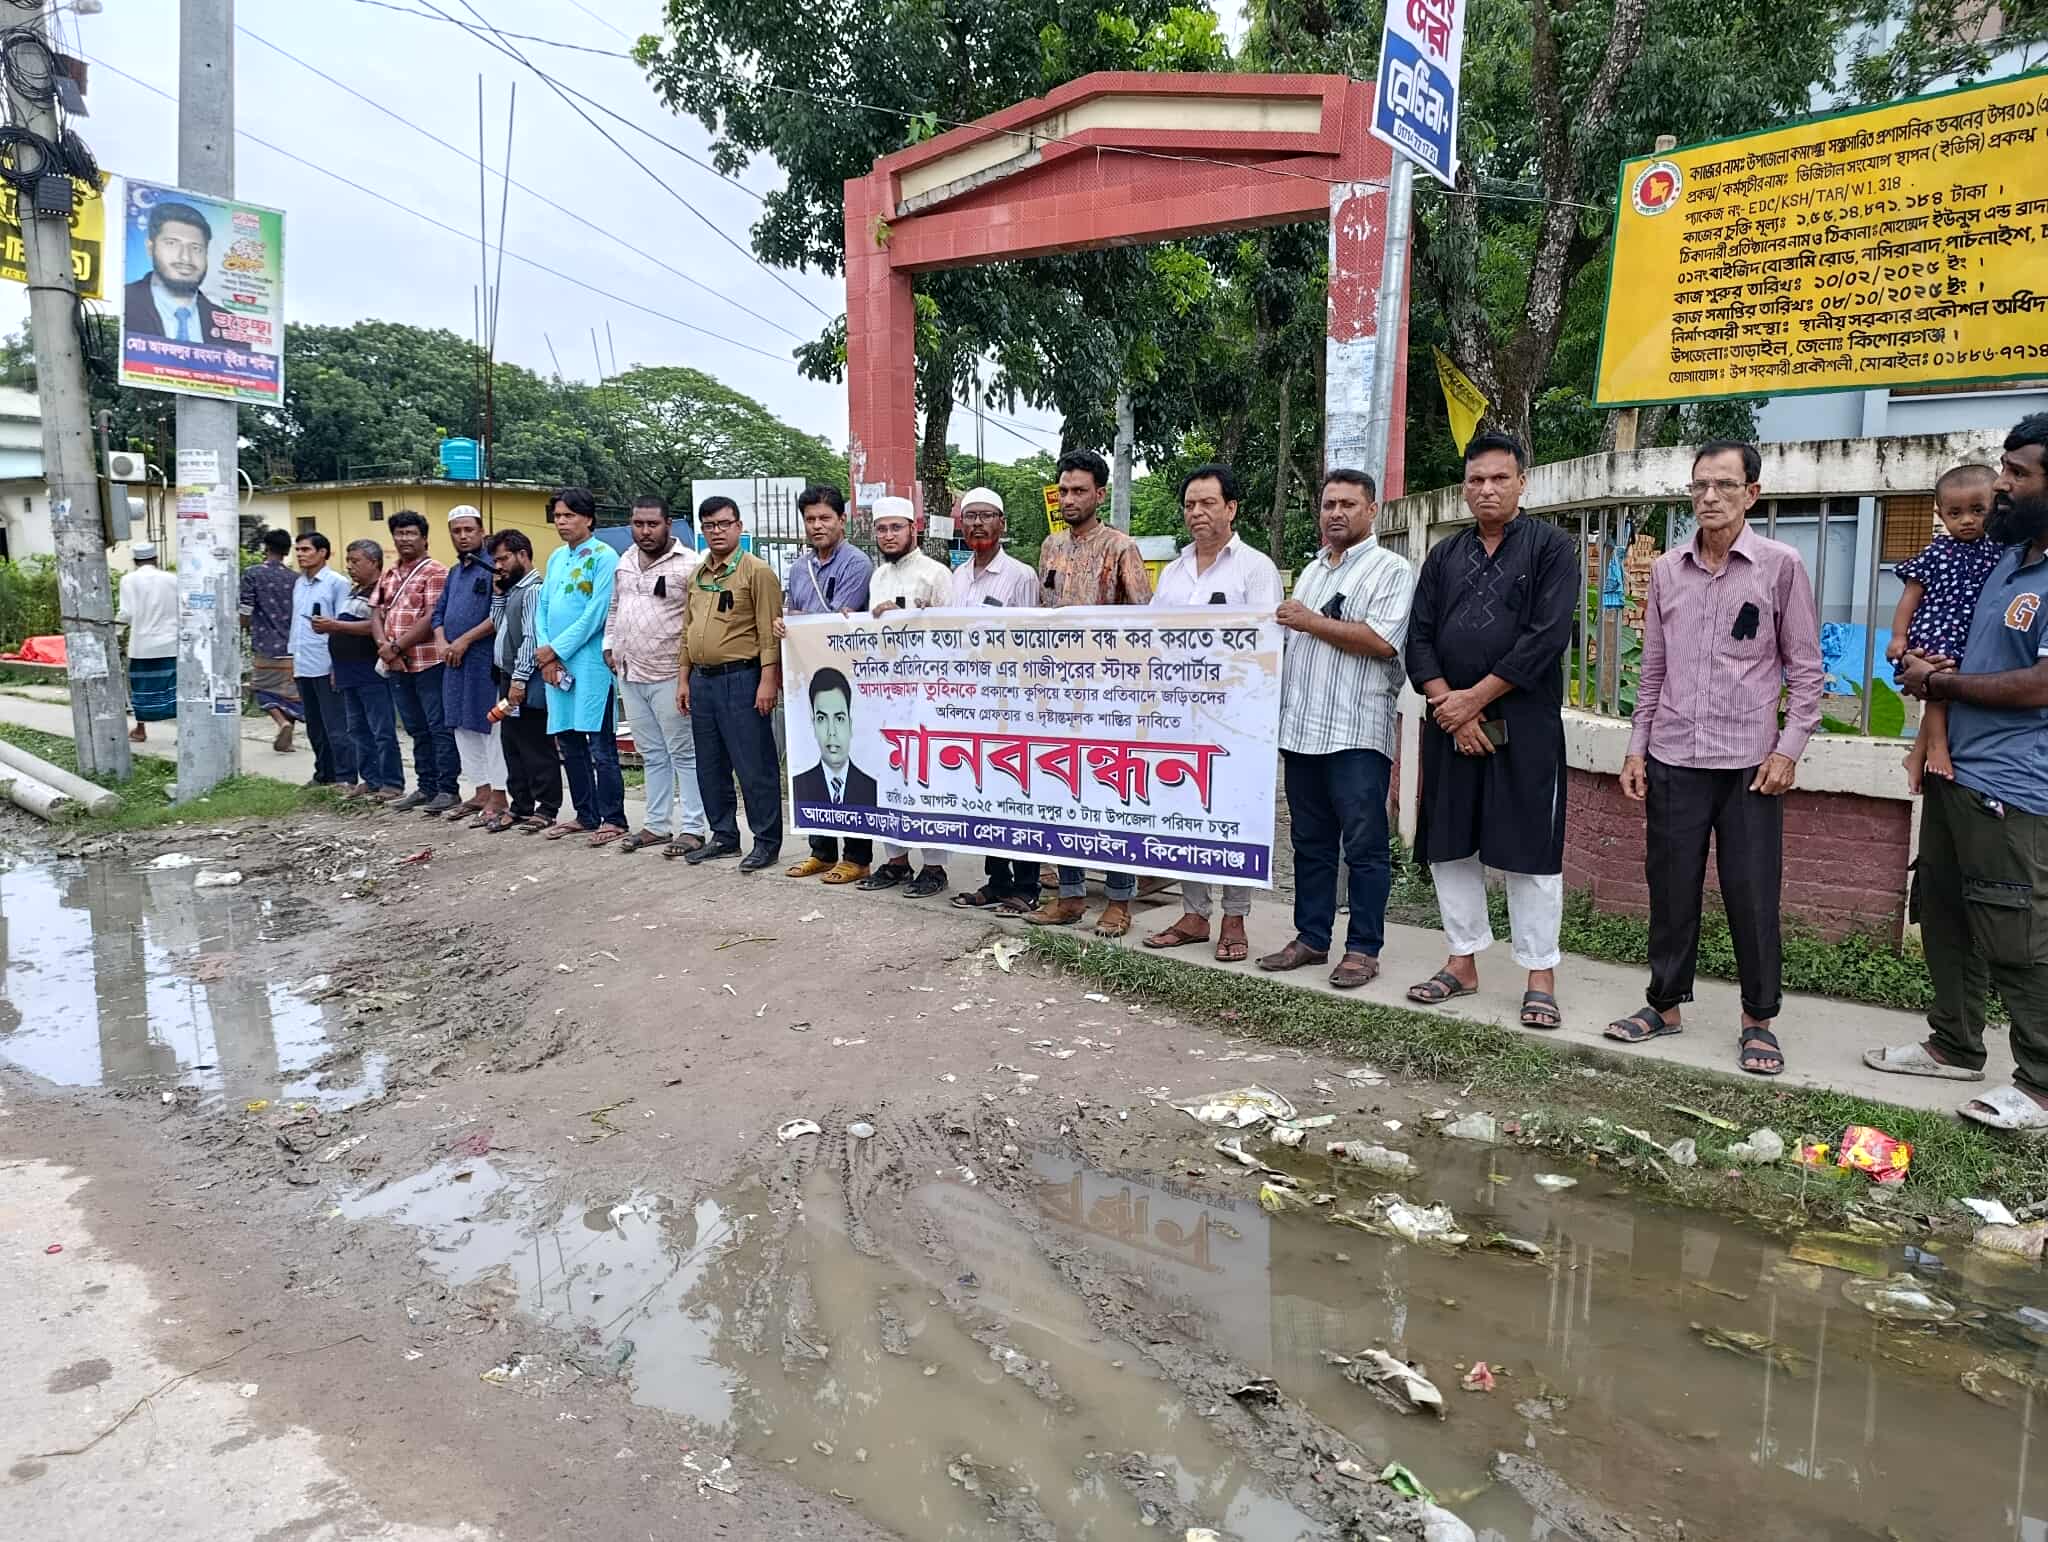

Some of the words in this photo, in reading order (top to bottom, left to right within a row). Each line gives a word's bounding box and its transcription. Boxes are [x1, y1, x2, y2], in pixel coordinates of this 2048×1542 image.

[1936, 109, 1984, 133] ভবনের
[1796, 162, 1845, 183] ডিজিটাল
[1683, 226, 1722, 244] কাজের
[1951, 184, 1987, 203] টাকা
[1674, 290, 1704, 305] কাজ
[1672, 310, 1703, 325] কাজ
[1848, 308, 1913, 328] সরকার
[2005, 592, 2040, 632] G
[826, 627, 878, 655] সাংবাদিক
[930, 628, 963, 650] হত্যা
[968, 630, 980, 647] ও
[984, 629, 1005, 648] মব
[1090, 628, 1118, 651] বন্ধ
[1122, 628, 1153, 649] কর
[1158, 628, 1215, 649] করতে
[1220, 628, 1259, 651] হবে
[851, 656, 889, 679] দৈনিক
[953, 659, 992, 678] কাগজ
[996, 660, 1018, 679] এর
[1023, 655, 1096, 684] গাজীপুরের
[1101, 656, 1143, 682] স্টাফ
[1147, 656, 1222, 683] রিপোর্টার
[922, 678, 977, 702] তুহিনকে
[1024, 684, 1060, 702] কুপিয়ে
[1063, 687, 1099, 703] হত্যার
[1102, 686, 1157, 703] প্রতিবাদে
[1161, 687, 1227, 707] জড়িতদের
[935, 703, 976, 722] অবিলম্বে
[979, 705, 1021, 722] গ্রেফতার
[1025, 710, 1034, 722] ও
[1098, 709, 1132, 728] শাস্তির
[1137, 711, 1182, 730] দাবিতে
[880, 723, 1230, 813] মানববন্ধন
[901, 812, 969, 840] উপজেলা
[973, 822, 1008, 843] প্রেস
[920, 793, 959, 809] আগস্ট
[961, 796, 992, 812] ২০২৫
[997, 796, 1034, 817] শনিবার
[1038, 802, 1062, 822] দুপুর
[1066, 808, 1077, 821] ৩
[1080, 804, 1102, 823] টায়
[1105, 805, 1157, 828] উপজেলা
[1161, 811, 1204, 834] পরিষদ
[1208, 820, 1241, 840] চত্বর
